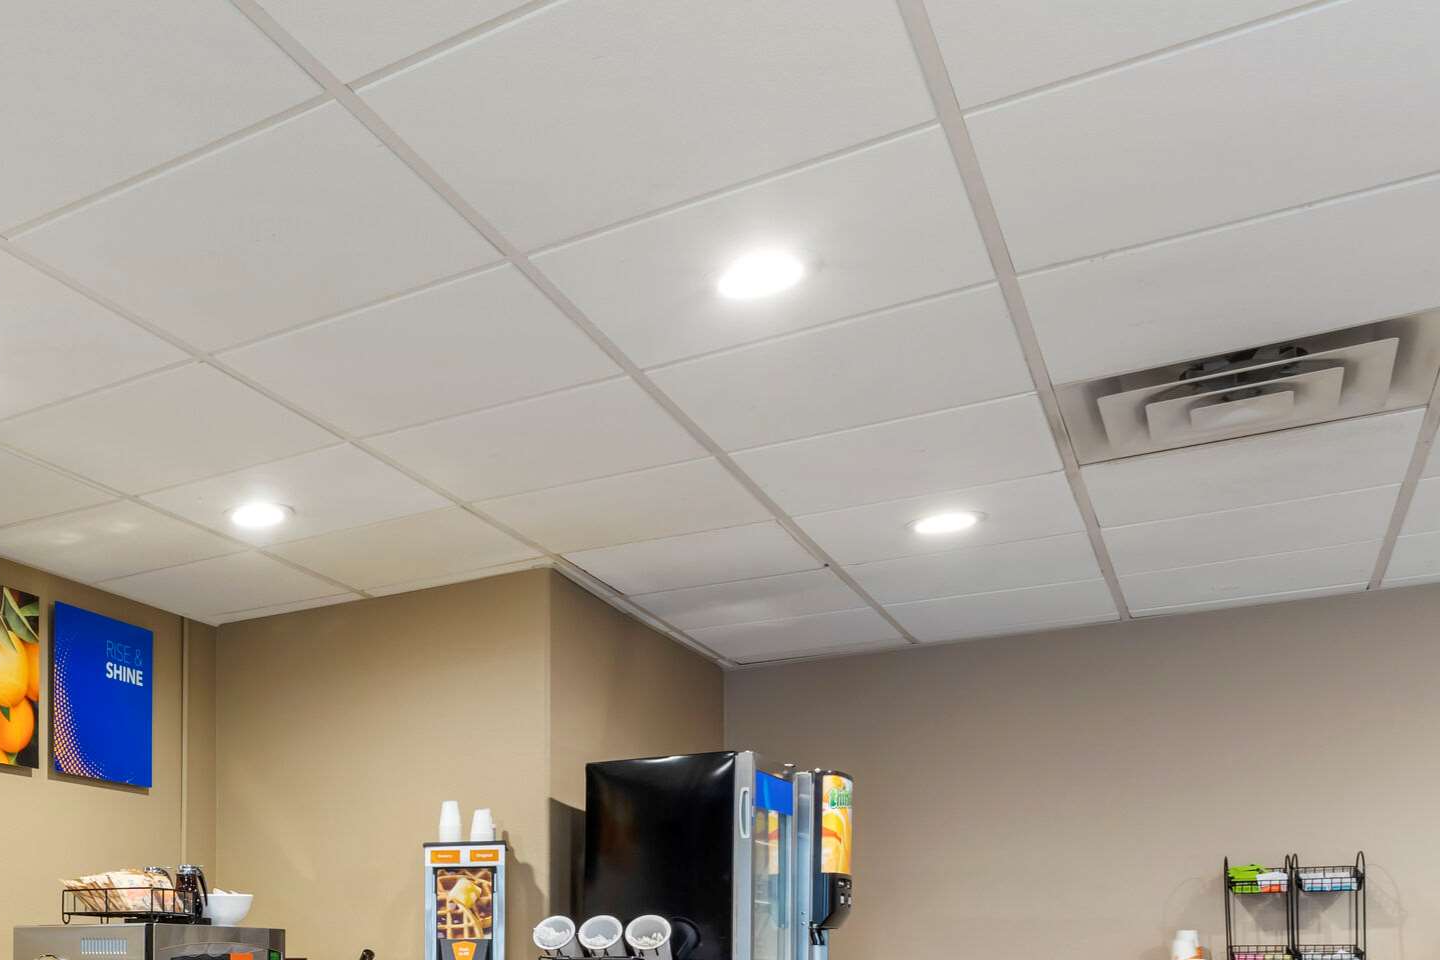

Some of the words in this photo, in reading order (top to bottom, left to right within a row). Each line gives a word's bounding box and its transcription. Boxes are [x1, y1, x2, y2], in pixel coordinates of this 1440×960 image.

[106, 639, 130, 664] RISE
[135, 648, 143, 667] &
[106, 661, 144, 687] SHINE
